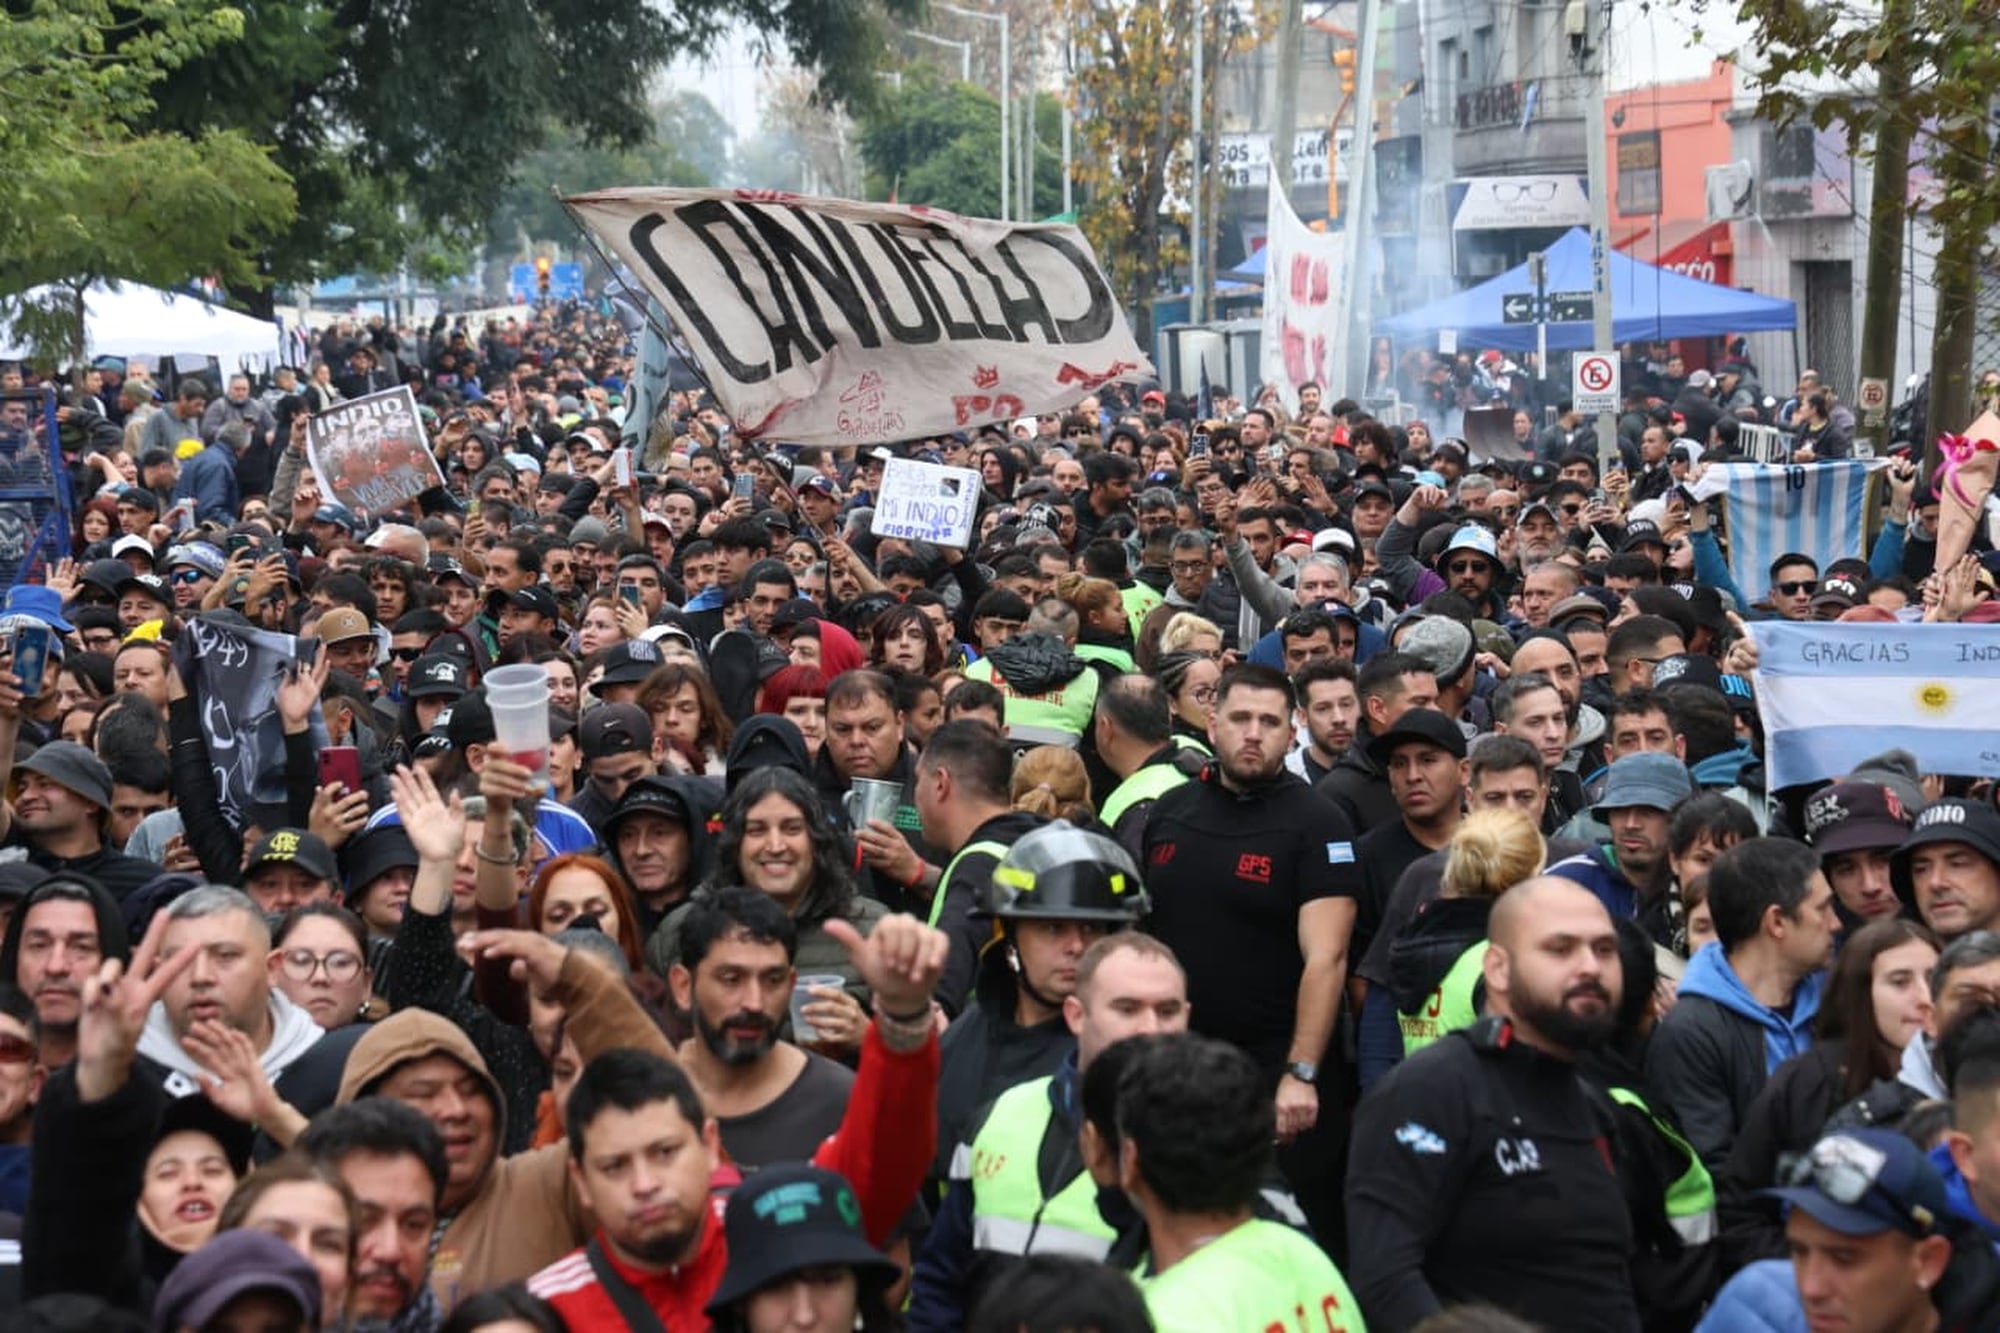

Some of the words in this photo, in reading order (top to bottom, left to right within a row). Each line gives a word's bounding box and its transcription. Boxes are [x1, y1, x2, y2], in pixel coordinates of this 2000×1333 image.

[315, 397, 403, 438] INDIO
[1784, 465, 1806, 492] 10
[906, 500, 959, 527] INDIO
[1801, 641, 1910, 667] GRACIAS
[1238, 853, 1272, 877] GPS
